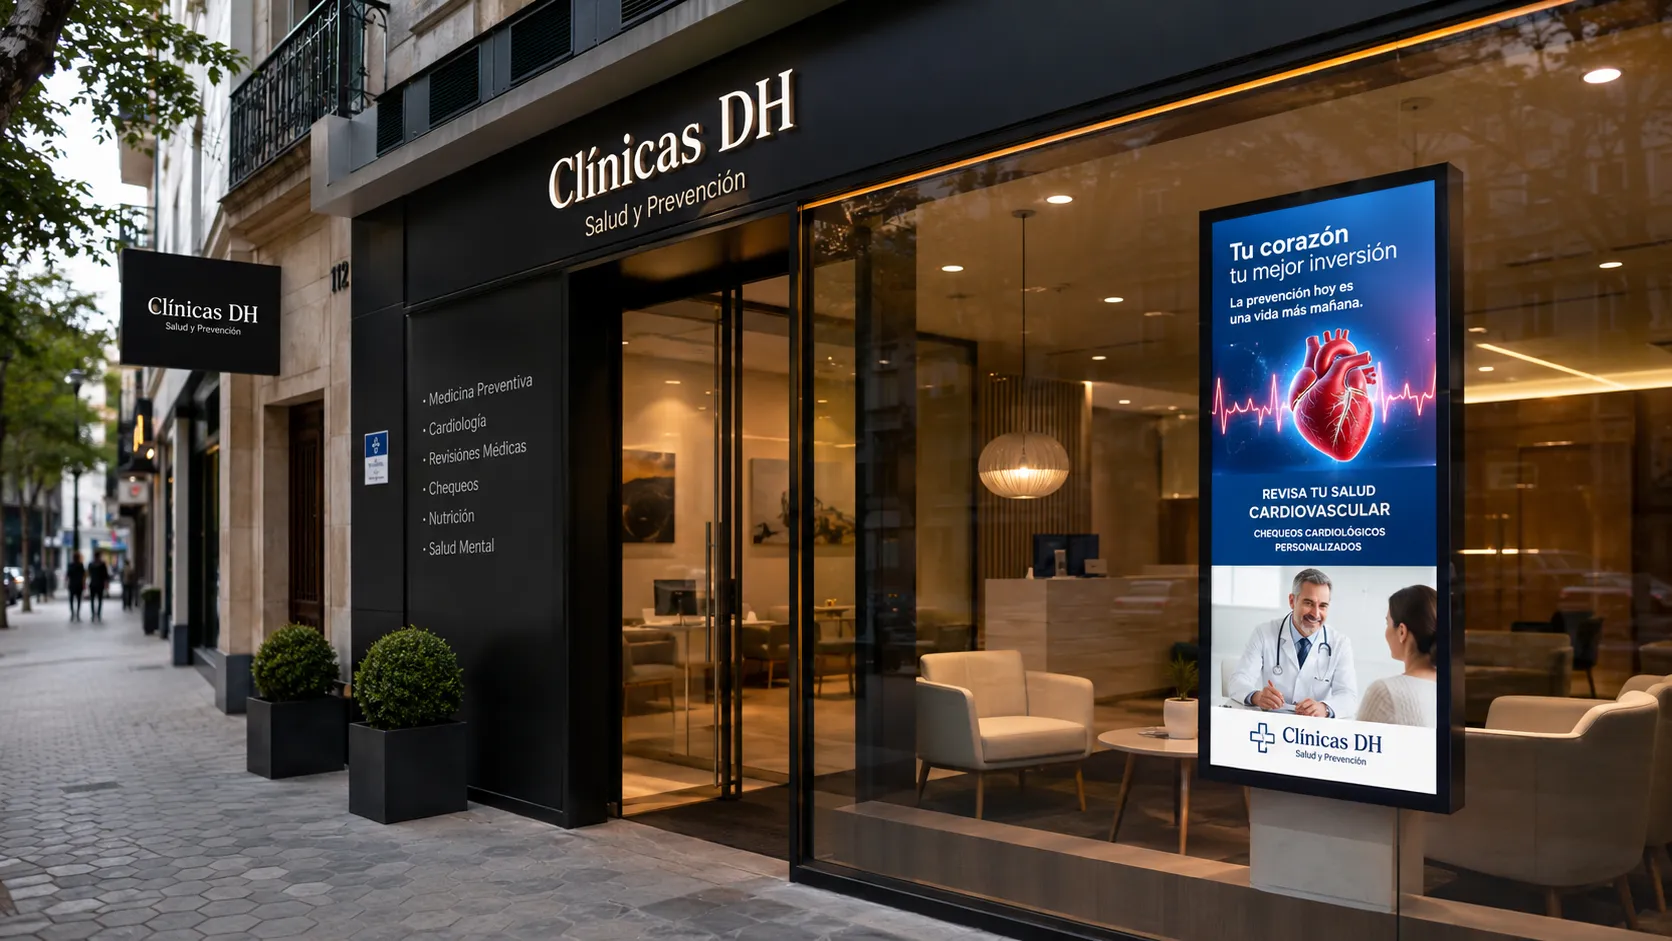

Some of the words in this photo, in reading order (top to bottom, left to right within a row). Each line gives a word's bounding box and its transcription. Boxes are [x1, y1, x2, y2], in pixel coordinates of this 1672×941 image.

[548, 122, 702, 210] Clínicas
[718, 68, 794, 153] DH
[585, 206, 628, 237] Salud
[633, 203, 643, 228] y
[647, 169, 746, 218] Prevención
[1229, 241, 1254, 262] Tu
[1260, 225, 1349, 257] corazón
[1229, 267, 1247, 284] tu
[1252, 258, 1304, 282] mejor
[1309, 242, 1397, 272] inversión
[331, 261, 349, 293] 112
[1230, 297, 1243, 308] La
[1246, 286, 1311, 309] prevención
[1313, 283, 1336, 298] hoy
[1339, 281, 1354, 292] es
[147, 296, 223, 321] Clínicas
[228, 303, 259, 324] DH
[1230, 313, 1251, 325] una
[1254, 308, 1279, 321] vida
[1282, 304, 1307, 318] más
[1310, 298, 1364, 314] mañana.
[165, 321, 189, 332] Salud
[190, 325, 196, 334] y
[197, 324, 242, 336] Prevención
[428, 387, 475, 406] Medicina
[477, 374, 534, 397] Preventiva
[428, 413, 487, 436] Cardiología
[428, 447, 481, 466] Revisiónes
[482, 440, 528, 460] Médicas
[428, 478, 480, 497] Chequeos
[1262, 487, 1308, 500] REVISA
[1310, 486, 1329, 499] TU
[1331, 484, 1377, 498] SALUD
[428, 507, 475, 526] Nutrición
[1249, 502, 1391, 519] CARDIOVASCULAR
[1253, 528, 1304, 539] CHEQUEOS
[1304, 525, 1387, 538] CARDIOLÓGICOS
[428, 540, 457, 556] Salud
[458, 537, 495, 554] Mental
[1274, 542, 1363, 553] PERSONALIZADOS
[1282, 726, 1348, 750] Clínicas
[1353, 733, 1383, 754] DH
[1295, 750, 1317, 760] Salud
[1318, 754, 1323, 763] y
[1324, 753, 1367, 766] Prevención
